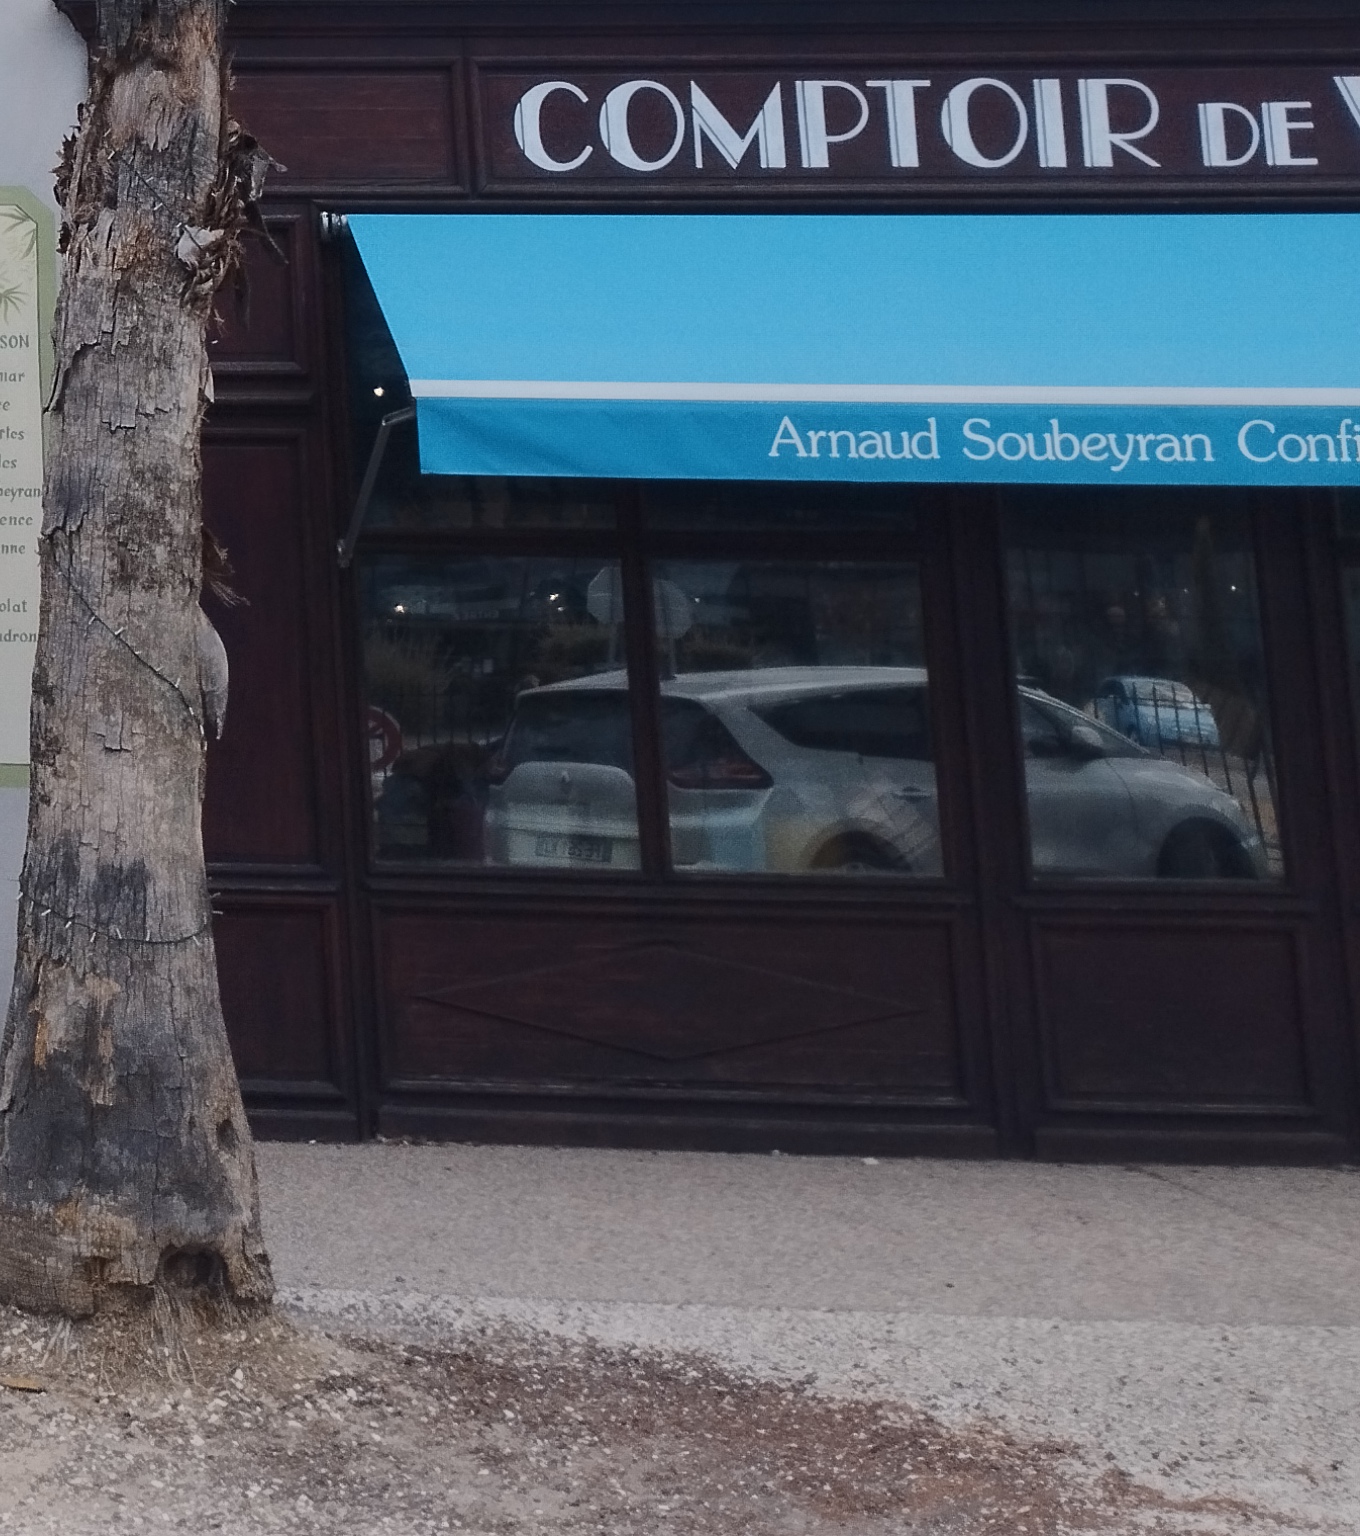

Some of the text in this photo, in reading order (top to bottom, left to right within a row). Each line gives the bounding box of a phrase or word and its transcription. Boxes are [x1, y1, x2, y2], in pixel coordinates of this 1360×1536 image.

[514, 78, 1162, 172] COMPTOIR
[1198, 101, 1319, 167] DE
[768, 416, 940, 461] Arnaud
[961, 418, 1213, 472] Soubeyran
